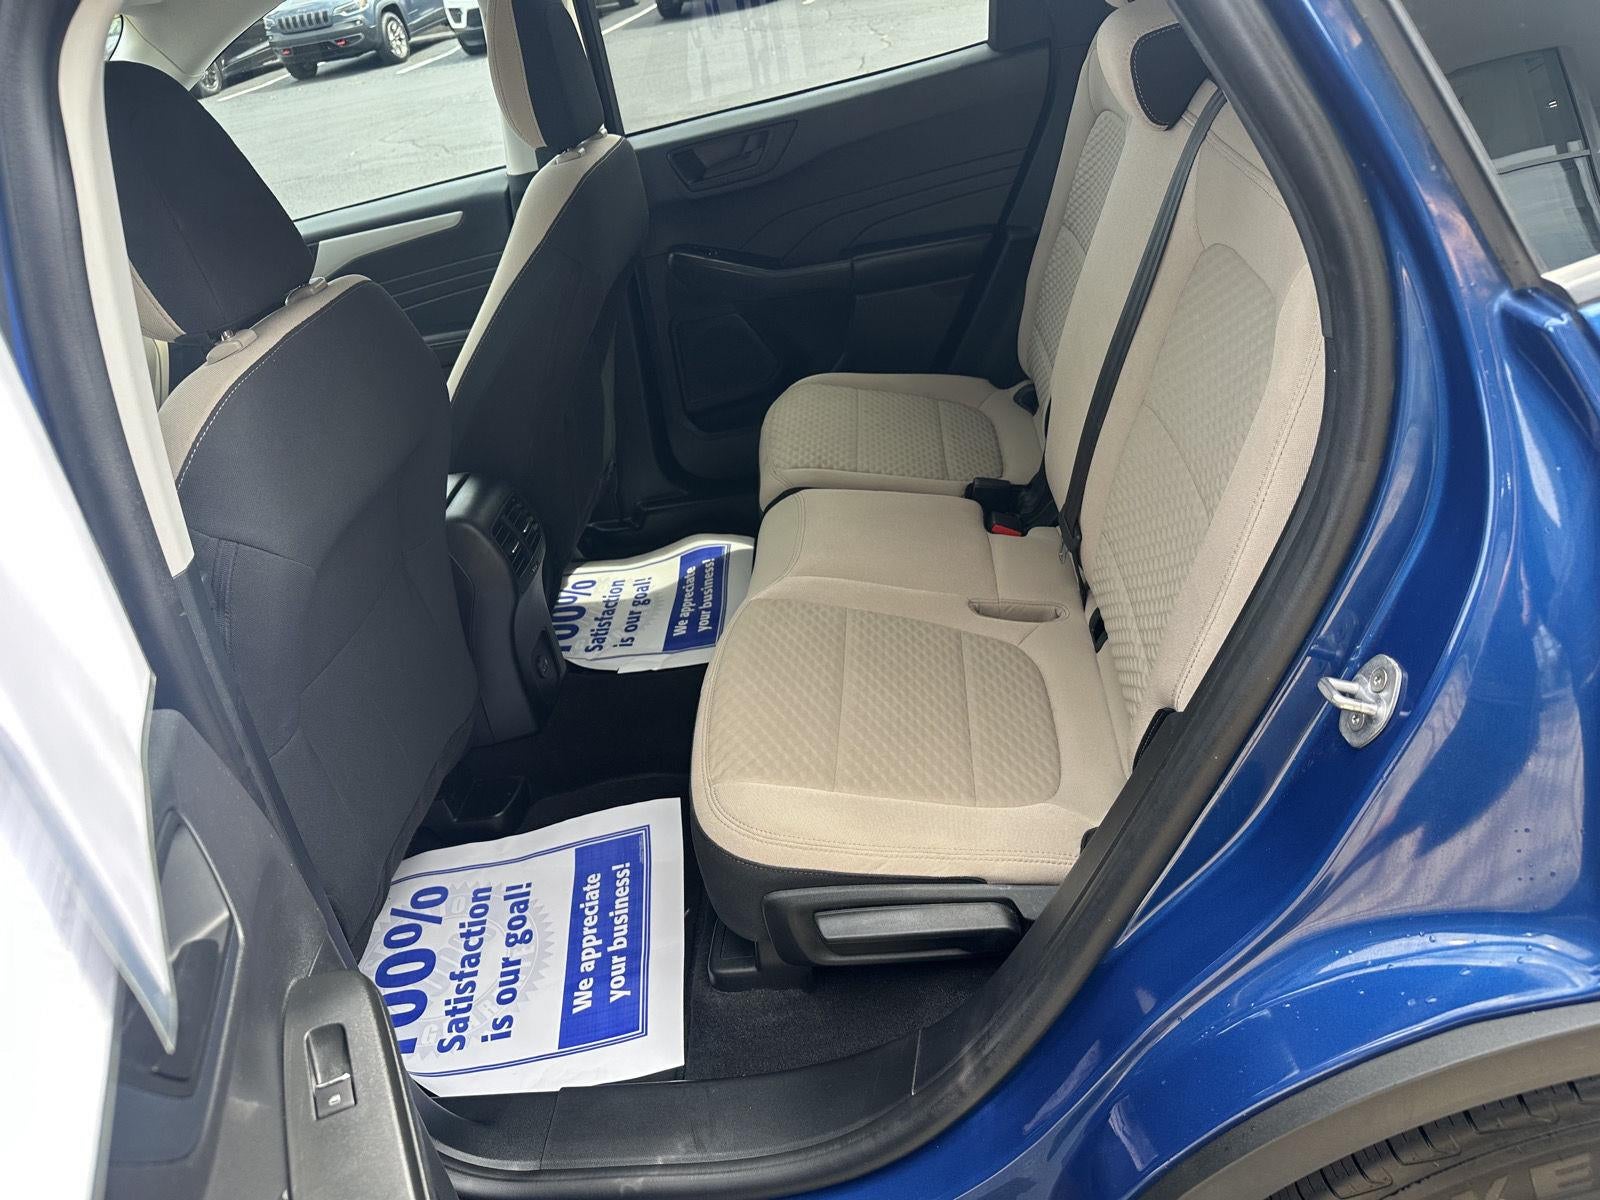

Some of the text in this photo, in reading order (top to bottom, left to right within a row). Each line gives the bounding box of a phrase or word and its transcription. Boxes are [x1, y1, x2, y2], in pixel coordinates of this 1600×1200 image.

[584, 579, 626, 653] Satisfaction
[613, 576, 653, 648] is our goal!
[673, 565, 697, 637] We appreciate
[698, 558, 716, 632] your business!
[437, 886, 493, 1053] Satisfaction
[481, 882, 534, 1043] is our goal!
[573, 872, 602, 1015] We appreciate
[607, 861, 631, 1003] your business!
